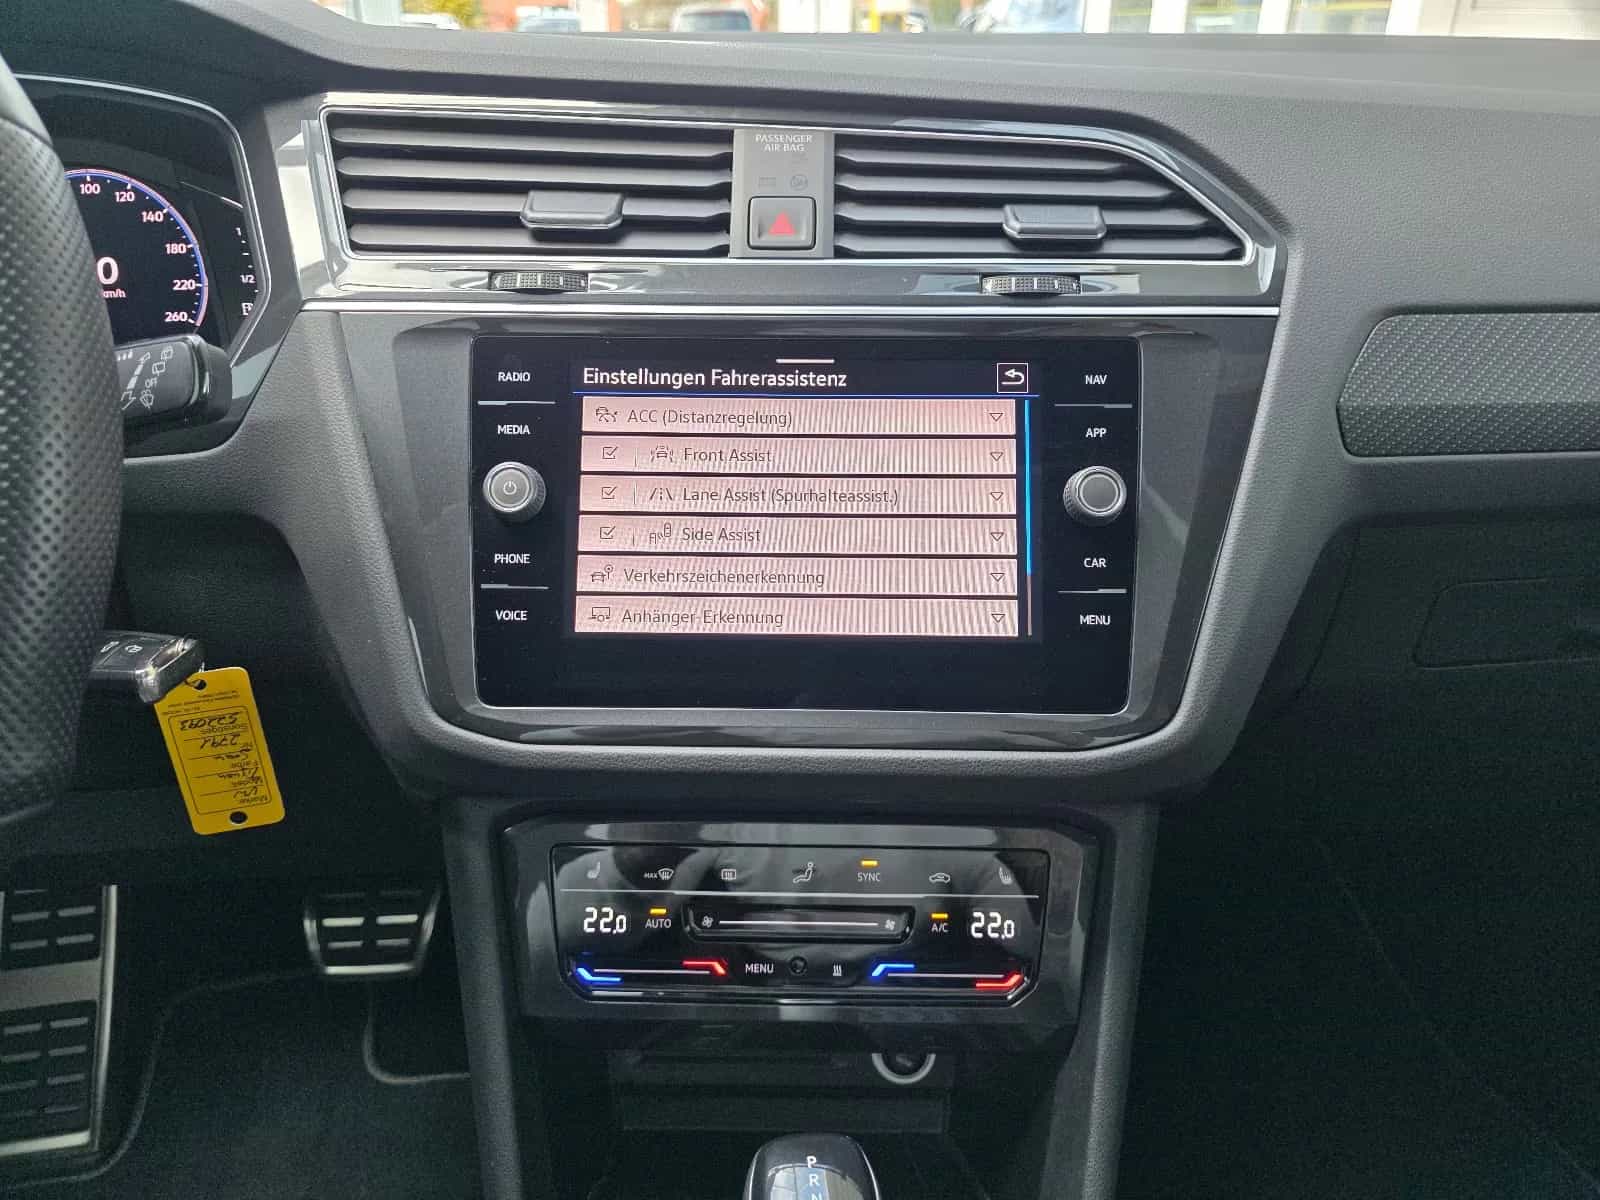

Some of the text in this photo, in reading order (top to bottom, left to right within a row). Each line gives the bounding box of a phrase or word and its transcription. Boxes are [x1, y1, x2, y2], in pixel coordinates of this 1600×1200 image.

[755, 134, 812, 143] PASSENGER
[764, 144, 805, 152] AIR BAG
[79, 183, 101, 194] 100
[114, 191, 135, 202] 120
[142, 211, 164, 222] 140
[165, 243, 187, 254] 180
[97, 256, 119, 285] 0
[172, 279, 196, 291] 220
[164, 311, 188, 322] 260
[497, 371, 531, 383] RADIO
[583, 367, 848, 389] Einstellungen Fahrerassistenz
[1085, 374, 1107, 386] NAV
[627, 409, 793, 428] ACC (Distanzregelung)
[497, 424, 531, 436] MEDIA
[1085, 427, 1107, 438] APP
[684, 448, 772, 462] Front Assist
[683, 487, 898, 506] Lane Assist (Spurhalteassist.)
[682, 527, 761, 542] Side Assist
[493, 553, 531, 565] PHONE
[1083, 557, 1107, 569] CAR
[624, 568, 825, 587] Verkehrszeichenerkennung
[495, 609, 528, 622] VOICE
[1079, 614, 1111, 626] MENU
[857, 872, 881, 882] SYNC
[644, 918, 672, 929] AUTO
[931, 922, 949, 932] A/C
[745, 963, 774, 974] MENU
[806, 1155, 817, 1168] P
[808, 1174, 819, 1186] R
